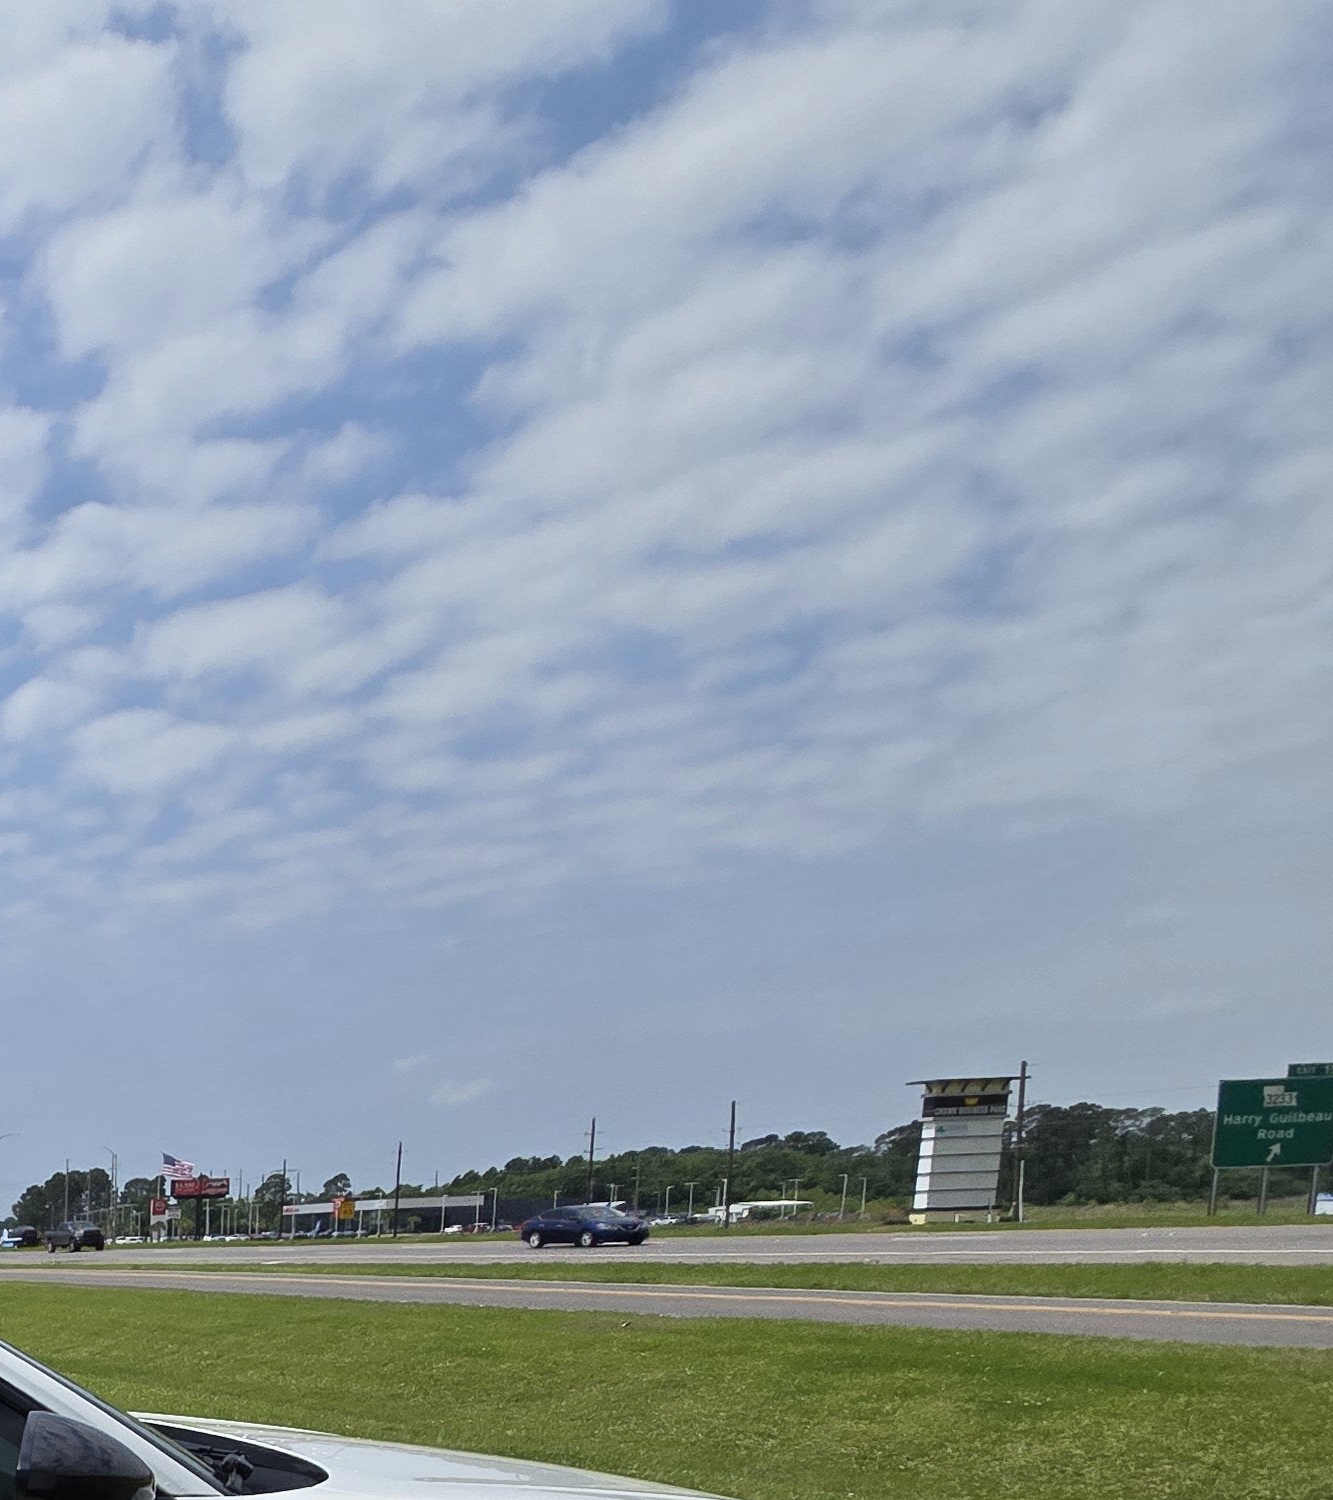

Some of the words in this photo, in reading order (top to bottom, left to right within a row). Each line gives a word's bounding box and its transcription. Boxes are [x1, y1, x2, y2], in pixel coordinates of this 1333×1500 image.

[1223, 1114, 1263, 1127] Harry
[1269, 1112, 1332, 1124] Guilbeau
[1257, 1128, 1295, 1139] Road
